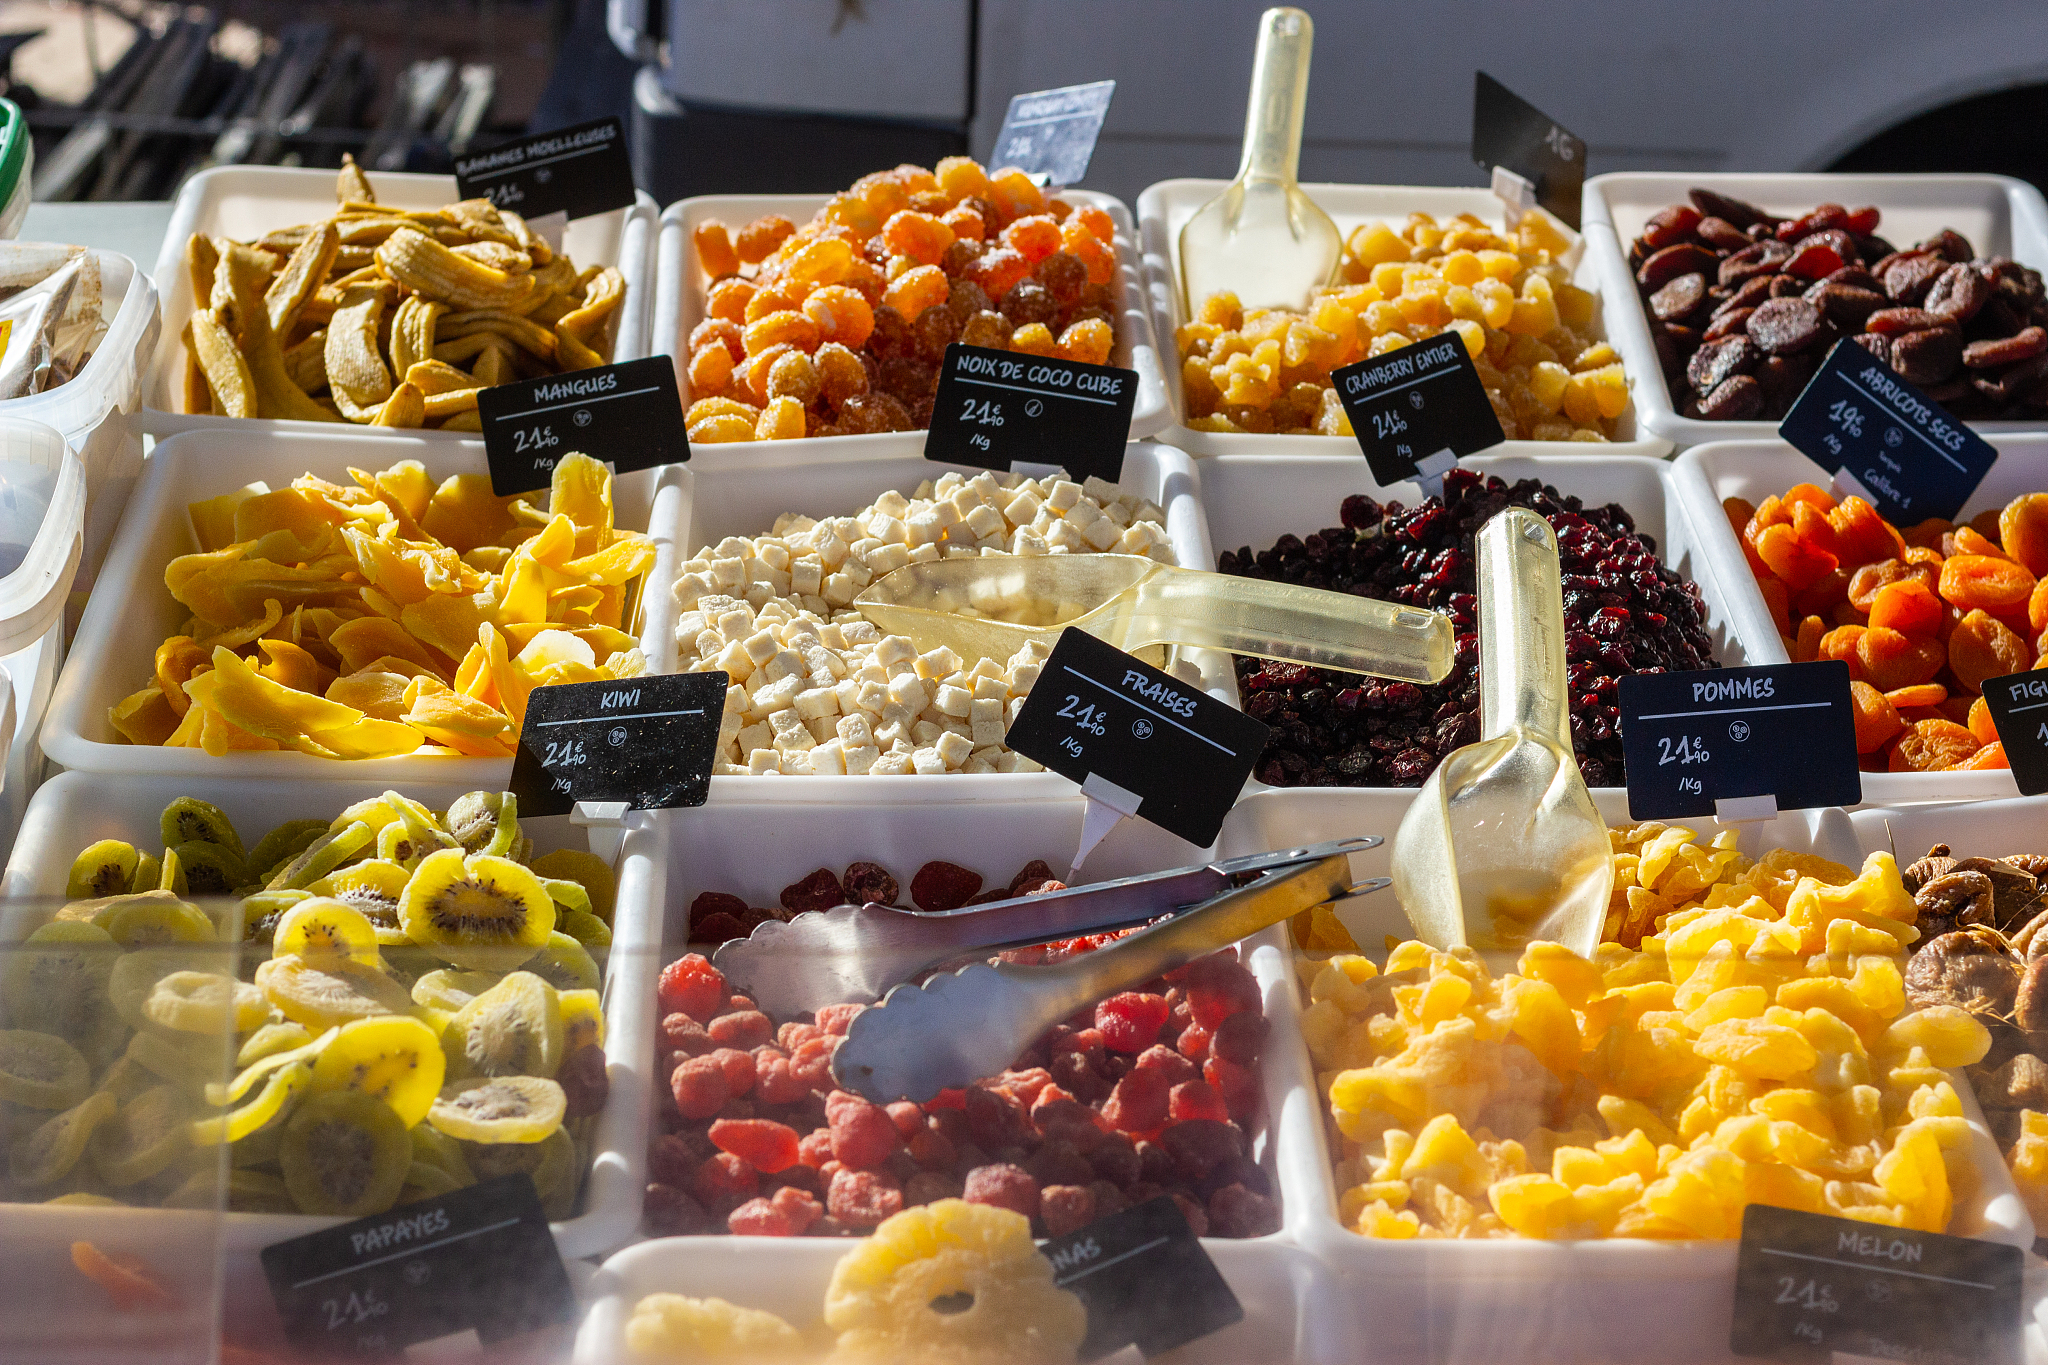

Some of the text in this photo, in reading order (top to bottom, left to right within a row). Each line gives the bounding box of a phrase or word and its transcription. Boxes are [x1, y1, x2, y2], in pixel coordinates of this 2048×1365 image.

[957, 355, 1123, 396] NOIX DE COCO CUBE
[1346, 343, 1458, 394] CRANBERRY ENTIER
[534, 373, 618, 403] MANGUES
[1860, 367, 1966, 451] ABRICOTS SECS
[601, 689, 641, 709] KIWI
[1121, 669, 1197, 718] FRAISES
[1692, 677, 1775, 702] POMMES
[1678, 777, 1702, 795] /Kg
[351, 1208, 450, 1255] PAPAYES
[1837, 1231, 1923, 1262] MELON
[1052, 1237, 1101, 1270] NAS
